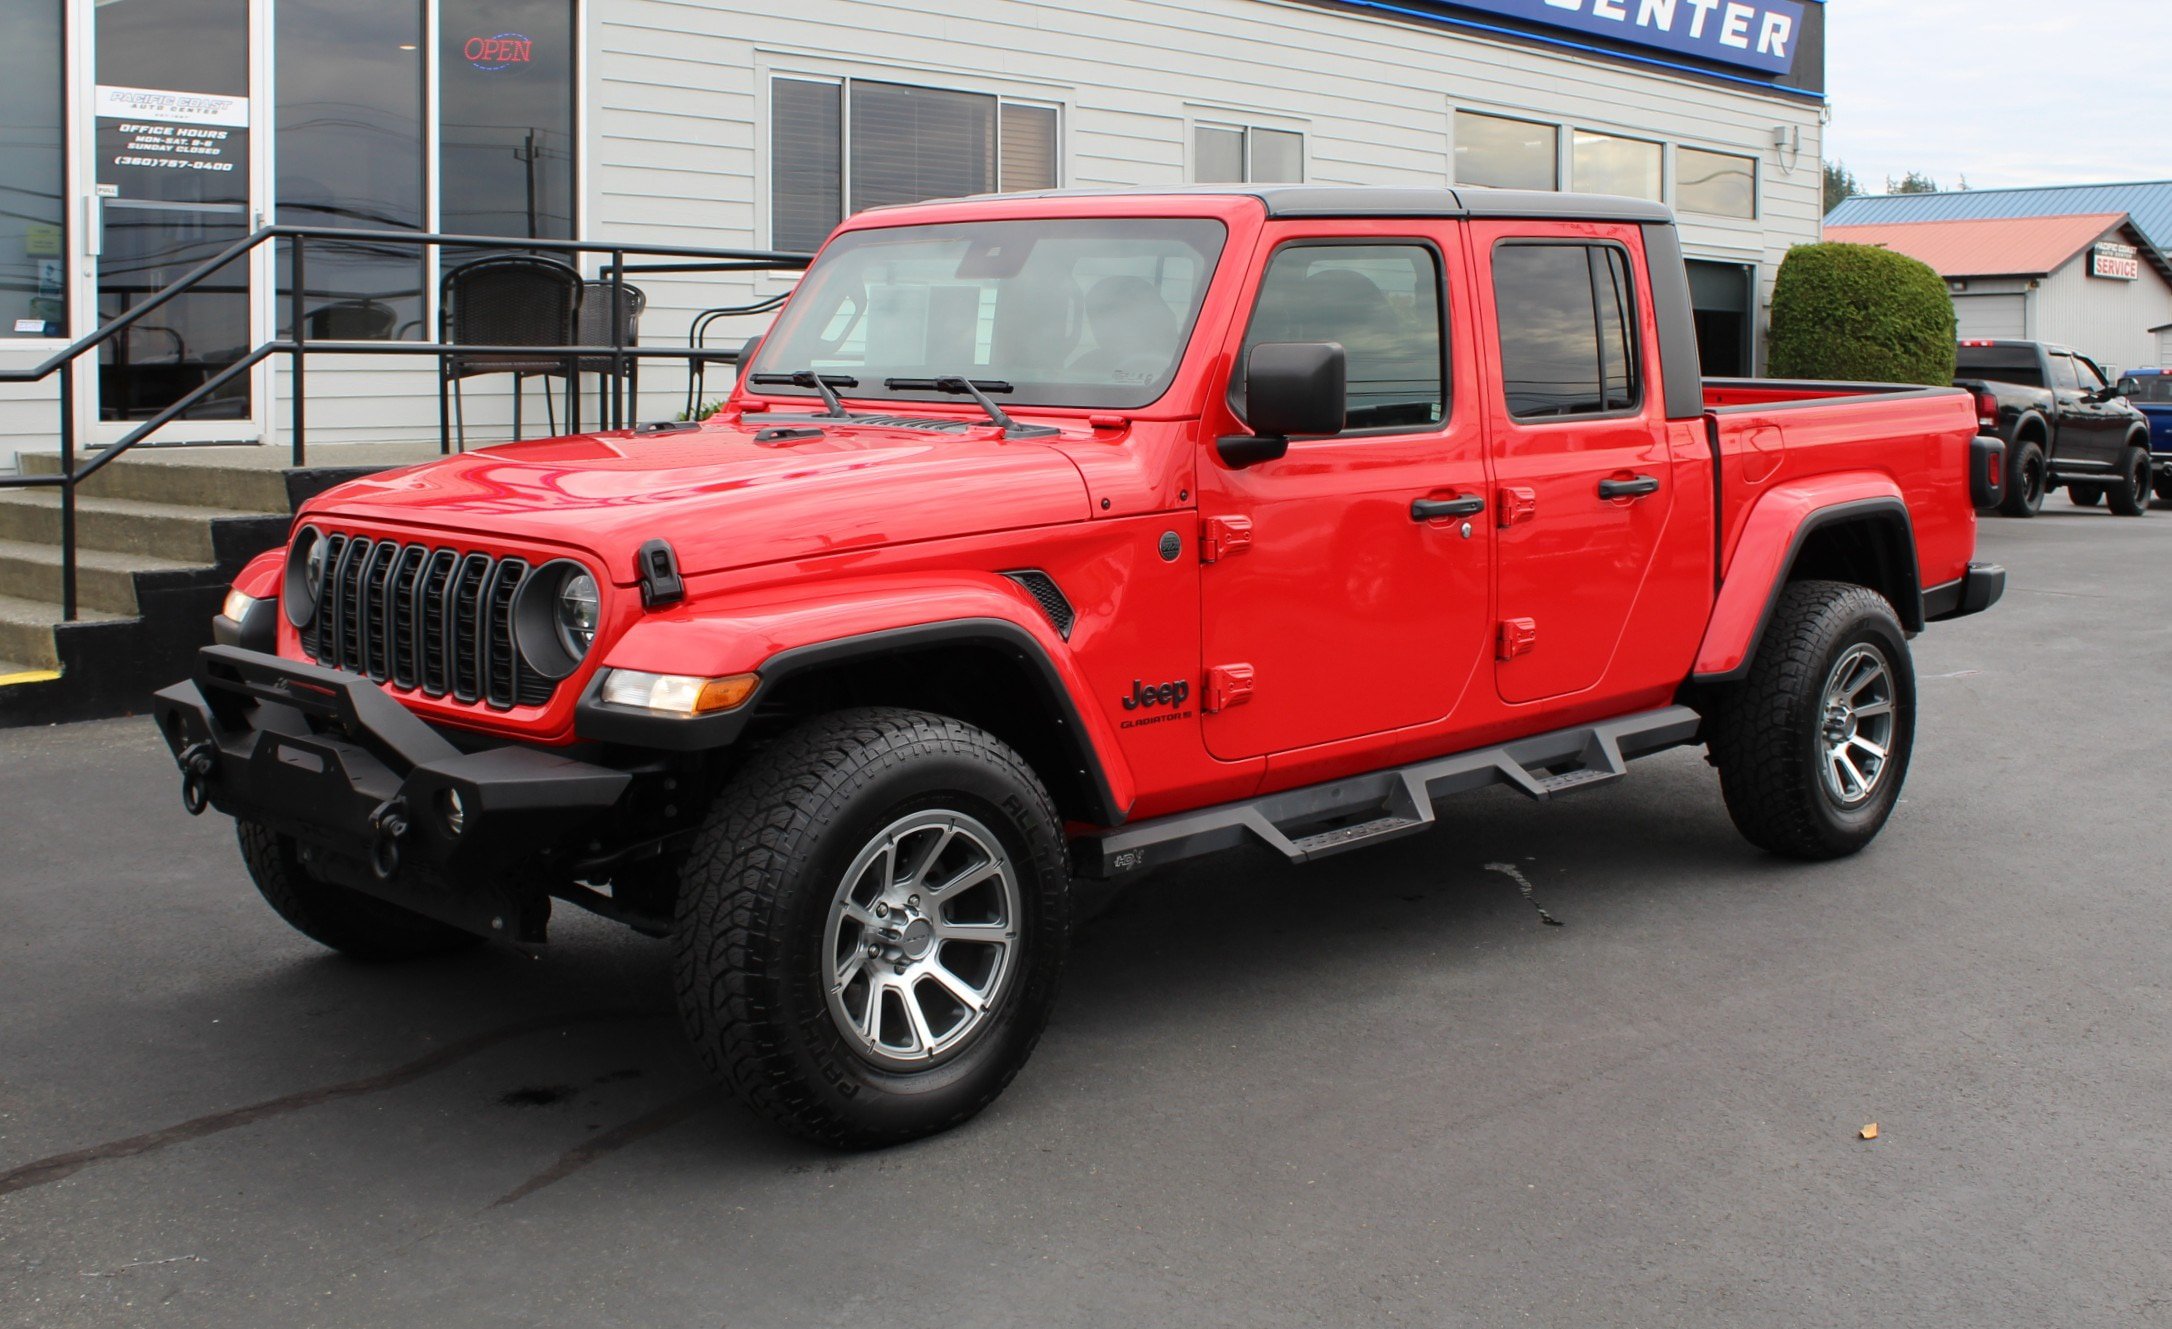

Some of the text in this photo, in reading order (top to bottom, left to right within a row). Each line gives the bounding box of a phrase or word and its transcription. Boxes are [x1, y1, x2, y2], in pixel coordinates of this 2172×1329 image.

[1544, 0, 1791, 58] ENTER
[464, 37, 532, 62] OPEN
[111, 92, 232, 110] PACIFIC COAST
[131, 103, 220, 115] AUTO CENTER
[119, 124, 228, 139] OFFICE HOURS
[127, 143, 221, 155] SUNDAY CLOSED
[135, 136, 189, 145] MON-SAT.
[2096, 258, 2136, 277] SERVICE
[1121, 679, 1189, 711] Jeep
[1120, 713, 1181, 729] GLADIATOR
